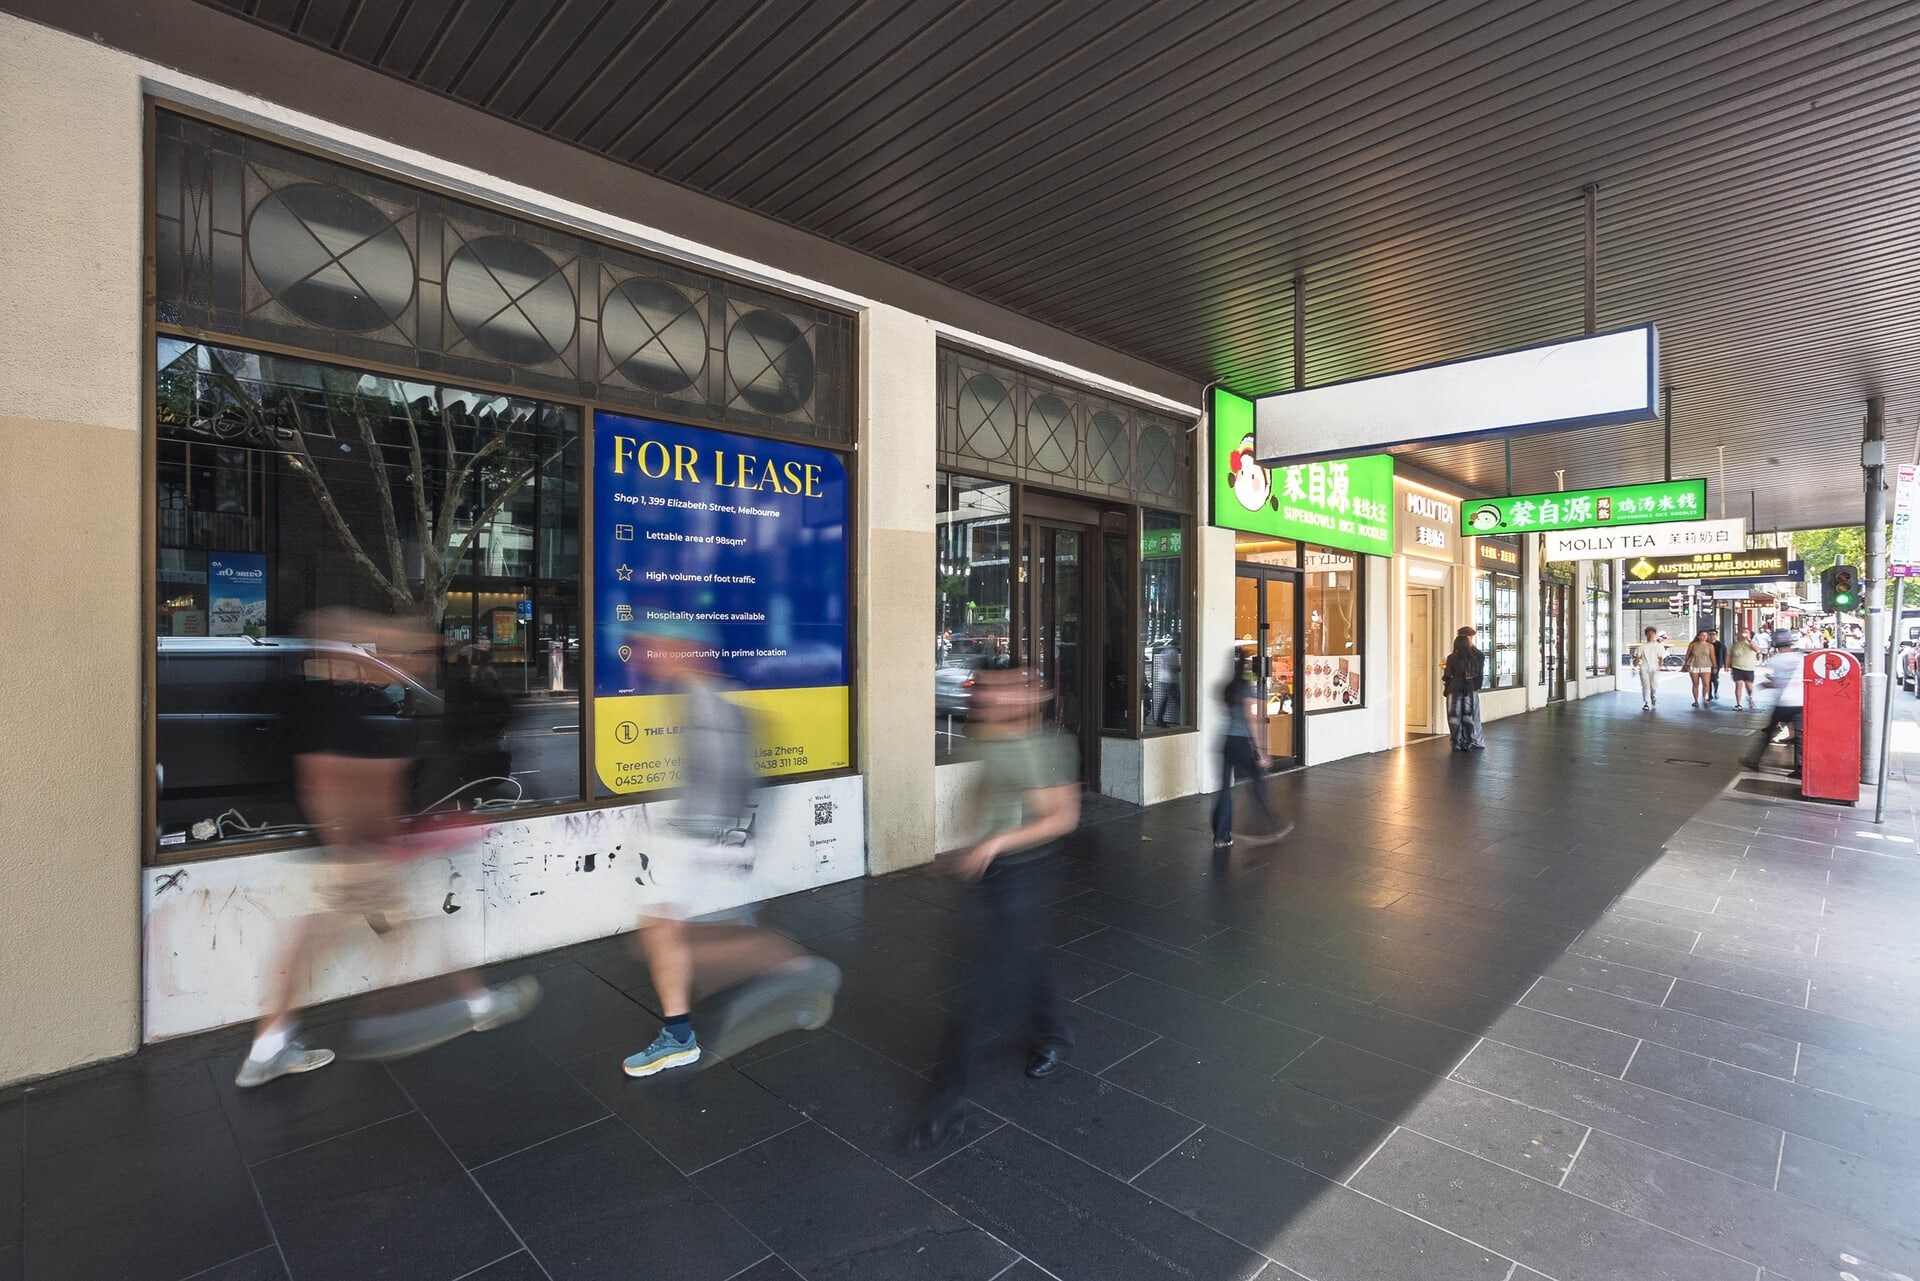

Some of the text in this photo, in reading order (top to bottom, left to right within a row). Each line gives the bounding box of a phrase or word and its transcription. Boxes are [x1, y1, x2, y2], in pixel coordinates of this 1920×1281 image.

[614, 436, 823, 498] FOR LEASE
[614, 493, 780, 518] Shop 1, 399 Elizabeth Street, Melbourne
[1406, 492, 1454, 524] MOLLY TEA
[1618, 492, 1697, 514] 鸡汤米线
[1509, 496, 1592, 528] 蒙自源
[1896, 514, 1909, 525] 2P
[646, 531, 683, 542] Lettable
[705, 536, 714, 544] of
[1339, 518, 1355, 534] RICE
[1358, 524, 1388, 542] NOODLES
[1669, 530, 1729, 545] 茉莉奶白
[1559, 534, 1656, 551] MOLLY TEA
[1657, 559, 1781, 574] AUSTRUMP MELBOURNE
[646, 572, 756, 584] High volume of foot traffic
[647, 611, 766, 622] Hospitality services available
[647, 648, 787, 661] Rare opportunity in prime location
[644, 725, 687, 736] THE LEA
[755, 746, 804, 759] Lisa Zheng
[616, 760, 661, 772] Terence
[754, 756, 808, 771] 0438 311 188
[615, 768, 690, 787] 0452 667 70
